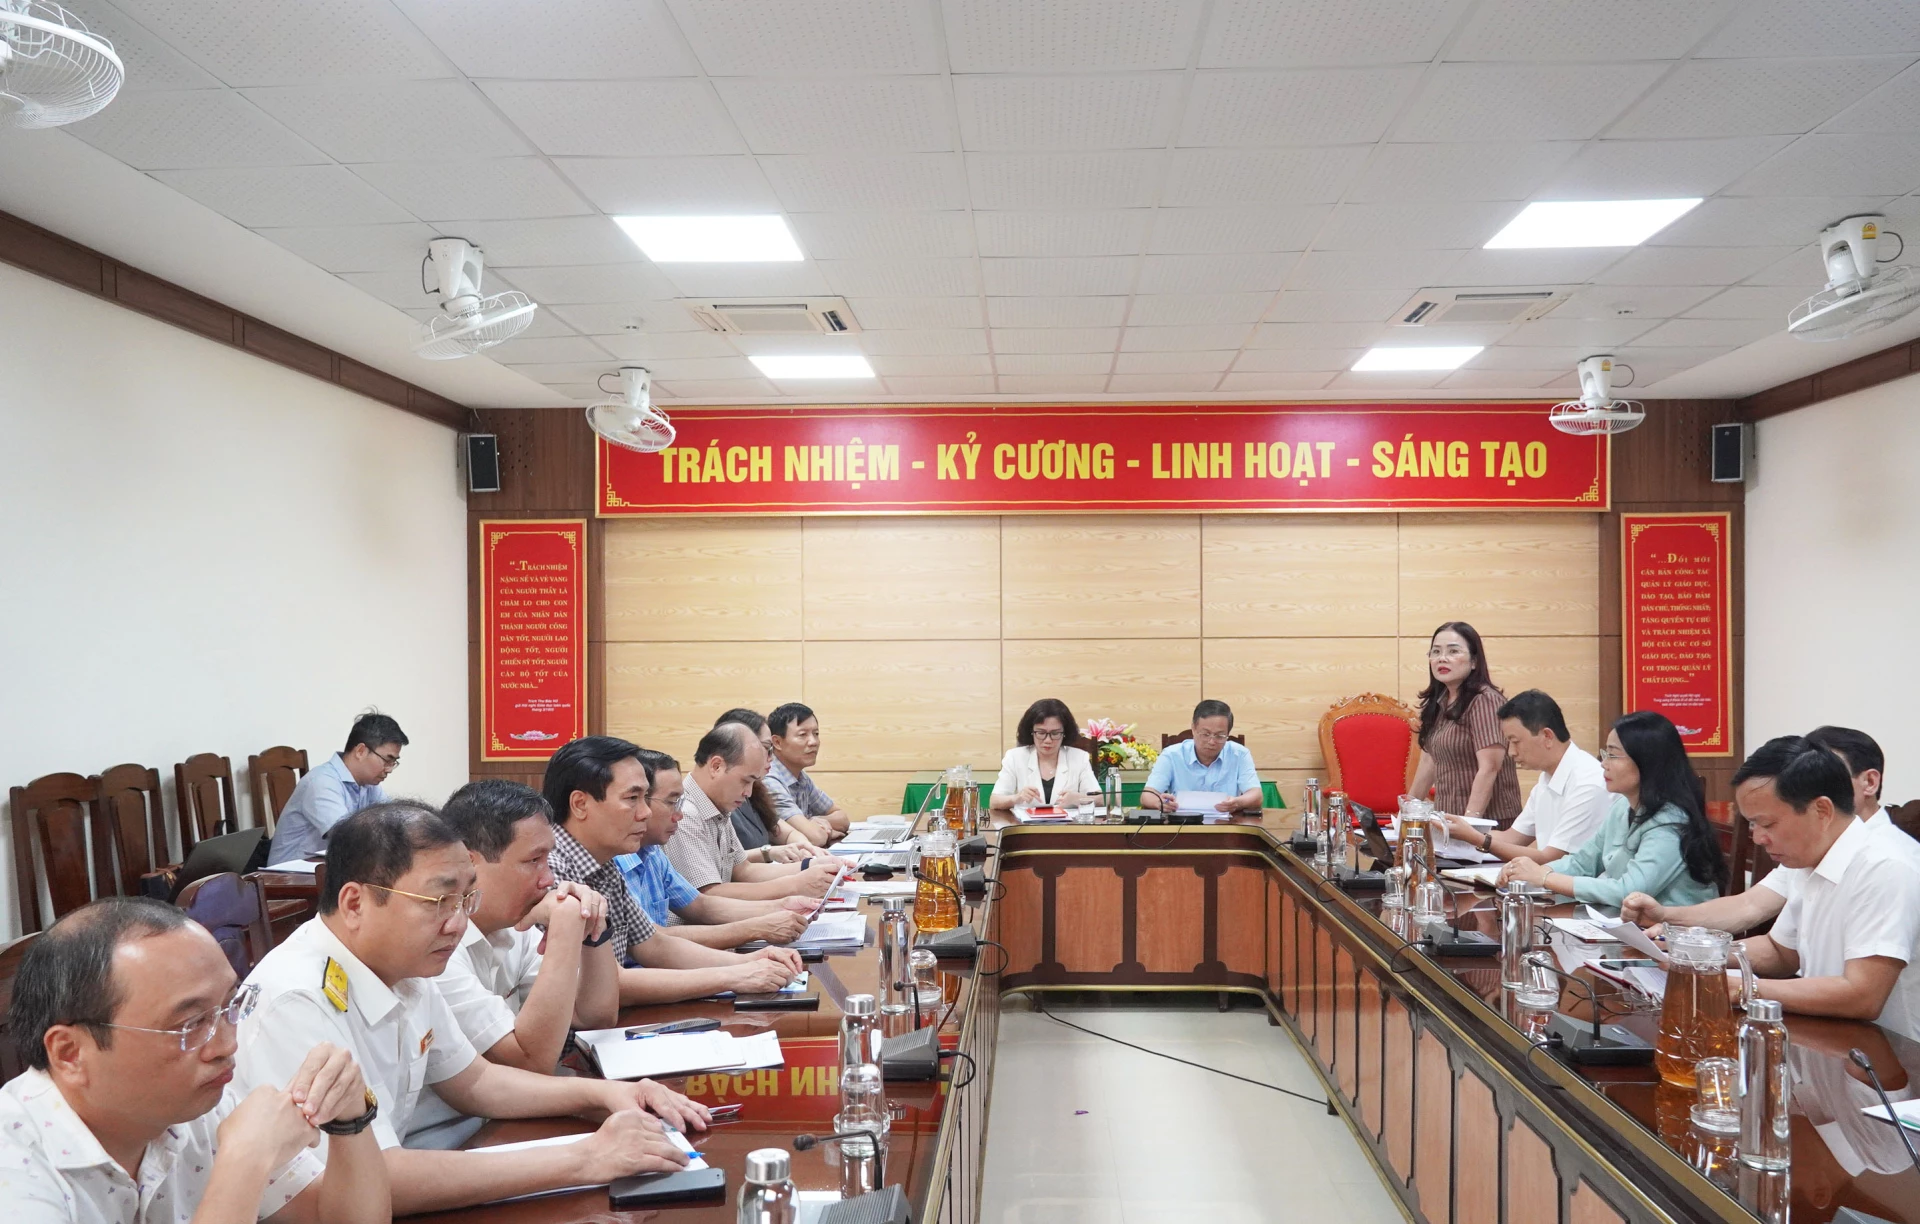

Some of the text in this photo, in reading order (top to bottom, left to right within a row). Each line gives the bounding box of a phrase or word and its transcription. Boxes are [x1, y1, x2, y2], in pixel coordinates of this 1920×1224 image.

[658, 438, 772, 484] TRÁCH
[784, 436, 899, 490] NHIỆM
[937, 430, 982, 480] KỶ
[993, 438, 1114, 480] CƯƠNG
[1152, 442, 1232, 479] LINH
[1245, 442, 1335, 486] HOẠT
[1372, 433, 1469, 478] SÁNG
[1480, 441, 1547, 486] TẠO
